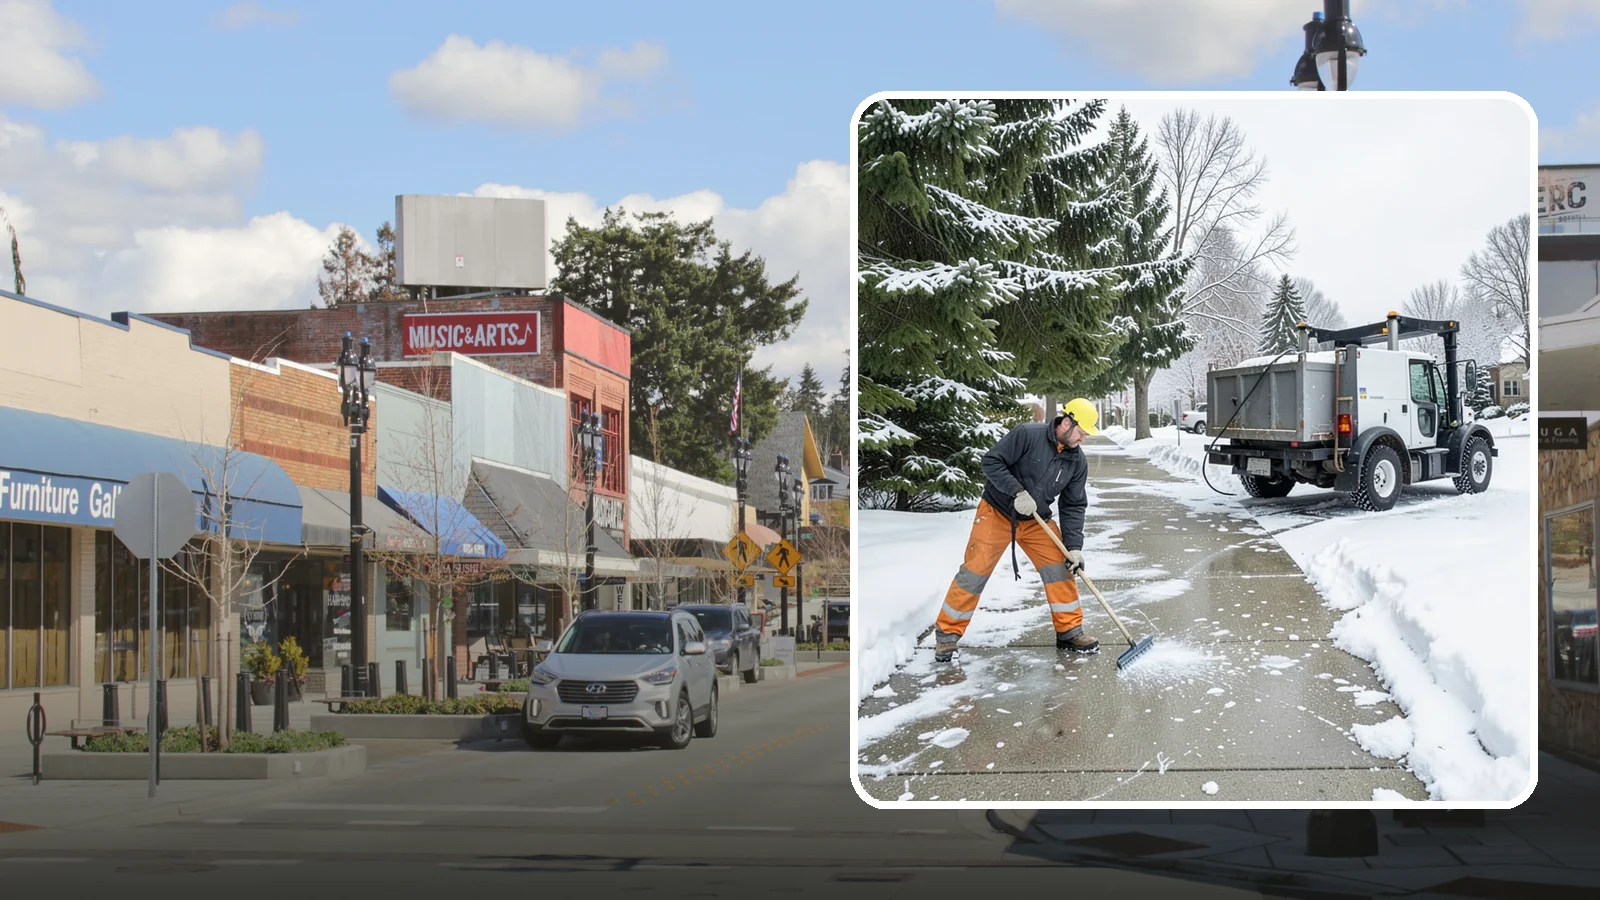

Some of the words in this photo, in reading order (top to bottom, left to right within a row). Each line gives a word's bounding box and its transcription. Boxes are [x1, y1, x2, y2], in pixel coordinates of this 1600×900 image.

[409, 323, 519, 349] MUSIC&ARTS
[1540, 428, 1577, 437] UGA
[0, 471, 79, 515] Furniture
[453, 563, 479, 574] SUSHI
